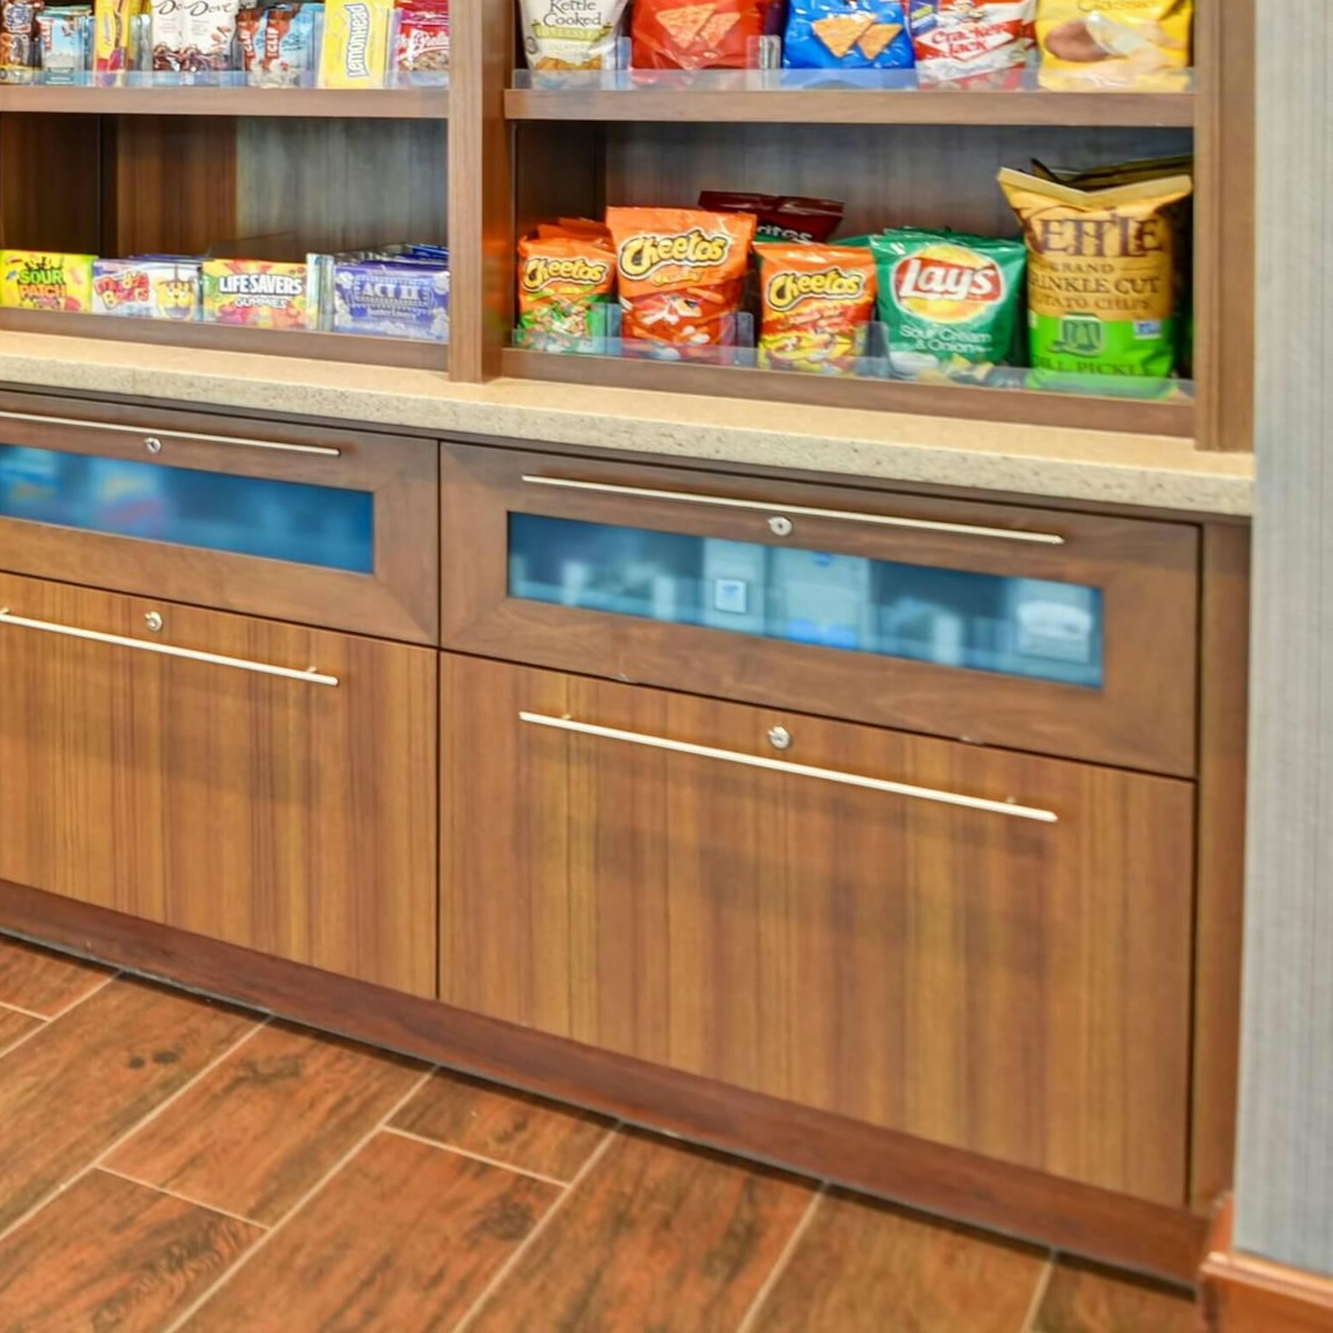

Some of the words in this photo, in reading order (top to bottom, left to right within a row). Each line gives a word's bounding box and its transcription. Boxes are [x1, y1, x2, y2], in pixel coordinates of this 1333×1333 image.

[183, 0, 234, 16] Dove
[543, 12, 602, 28] Cooked
[931, 20, 1007, 44] Craker
[757, 224, 814, 242] ritos
[620, 229, 729, 279] Cheetos
[18, 267, 65, 284] SOUR
[523, 259, 605, 290] Cheetos
[19, 284, 67, 299] PATCH
[361, 281, 396, 300] ACT
[767, 268, 864, 308] Cheetos
[1114, 274, 1160, 295] CUT
[235, 296, 289, 309] GUMMIES
